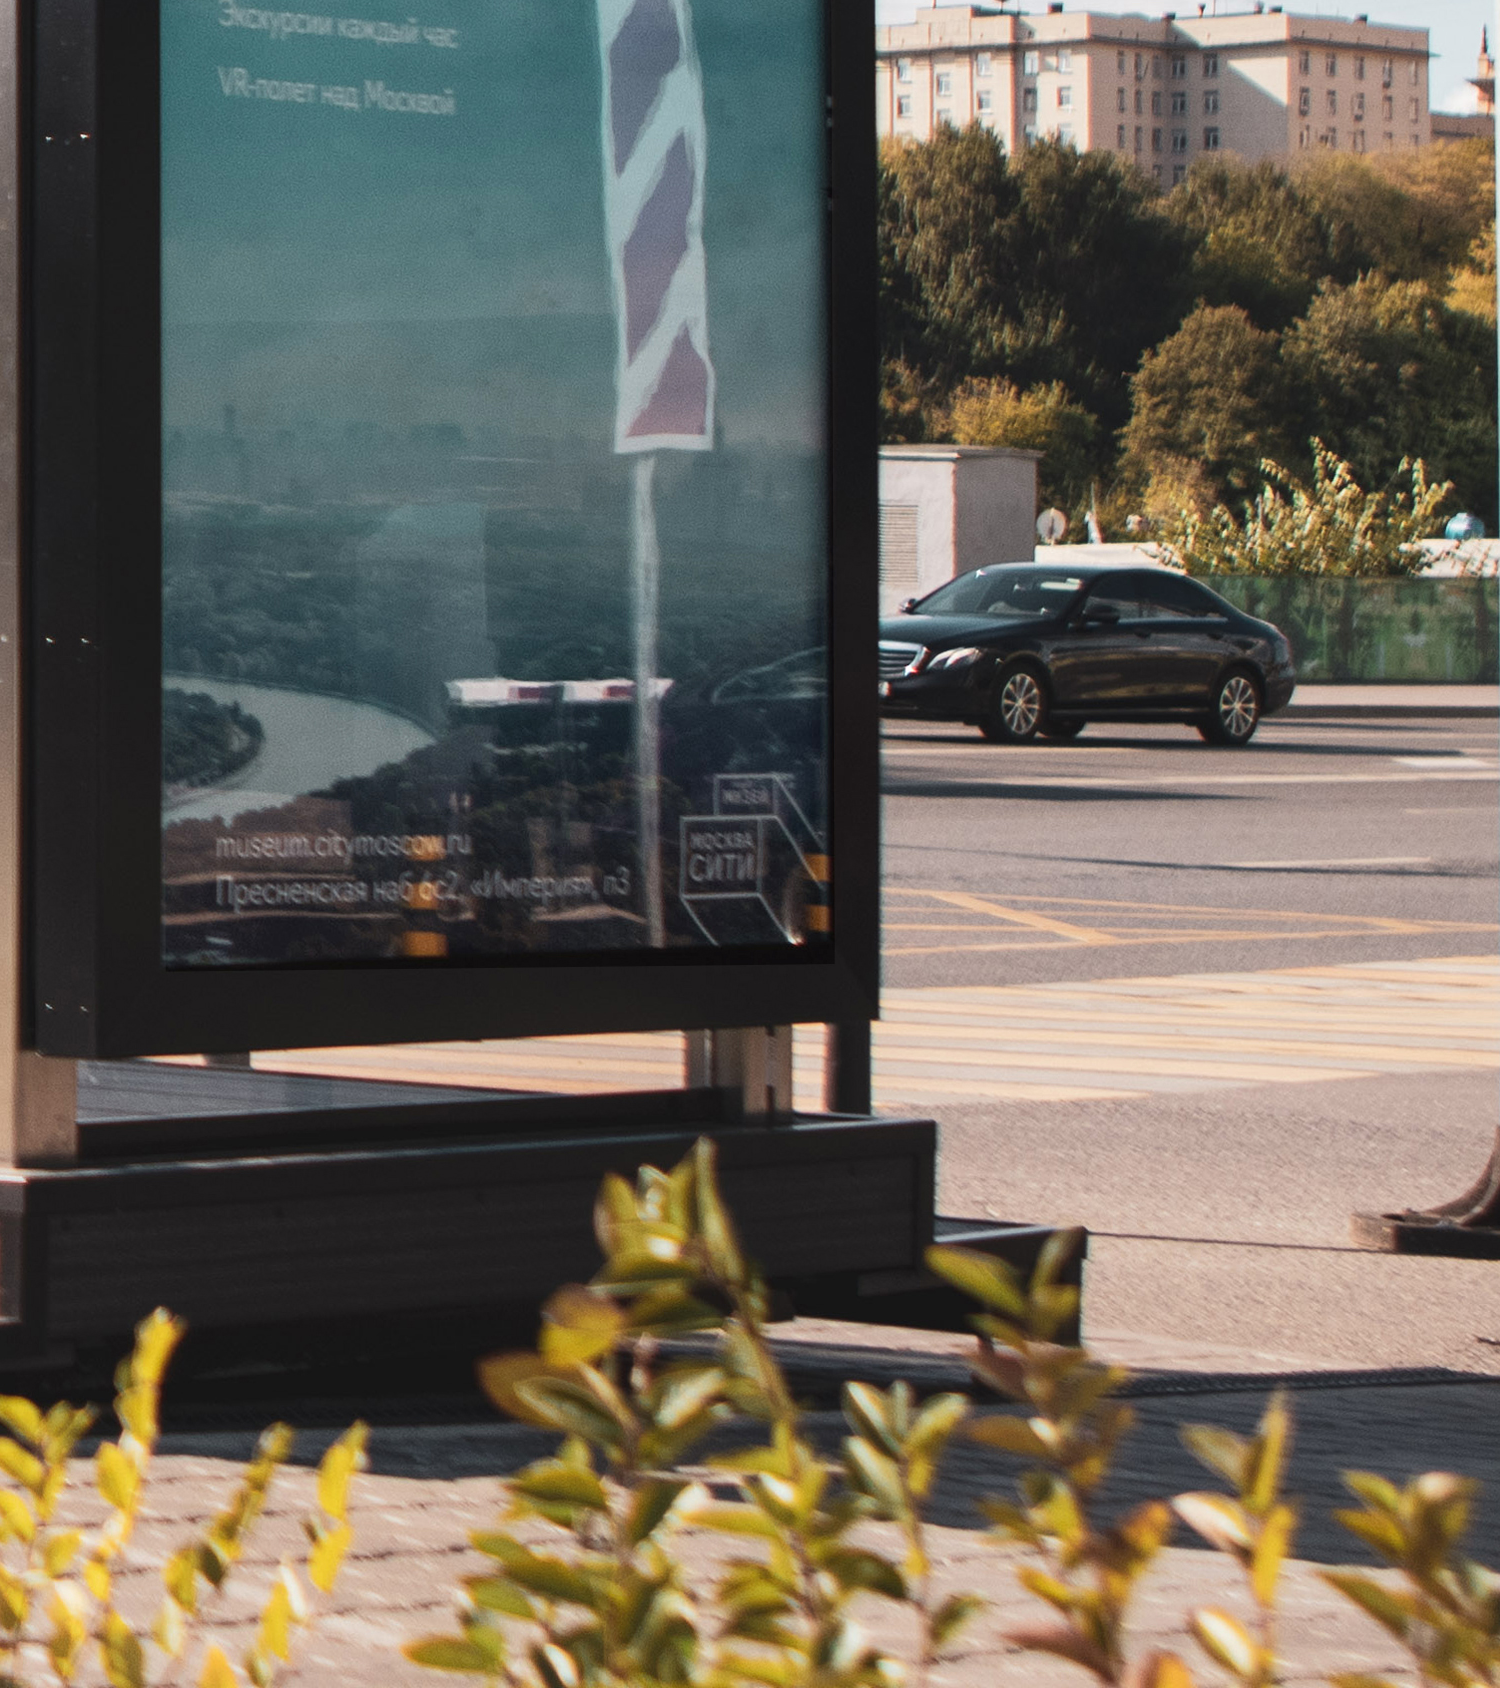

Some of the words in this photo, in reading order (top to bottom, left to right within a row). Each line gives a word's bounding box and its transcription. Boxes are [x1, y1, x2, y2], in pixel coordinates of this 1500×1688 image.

[337, 16, 421, 48] каждый
[422, 26, 461, 50] час
[216, 65, 317, 104] VR-полет
[319, 85, 359, 112] над
[362, 78, 457, 115] Москвой
[689, 831, 757, 852] МОСКВА
[688, 852, 757, 884] СИТИ
[214, 874, 369, 913] Пресненская
